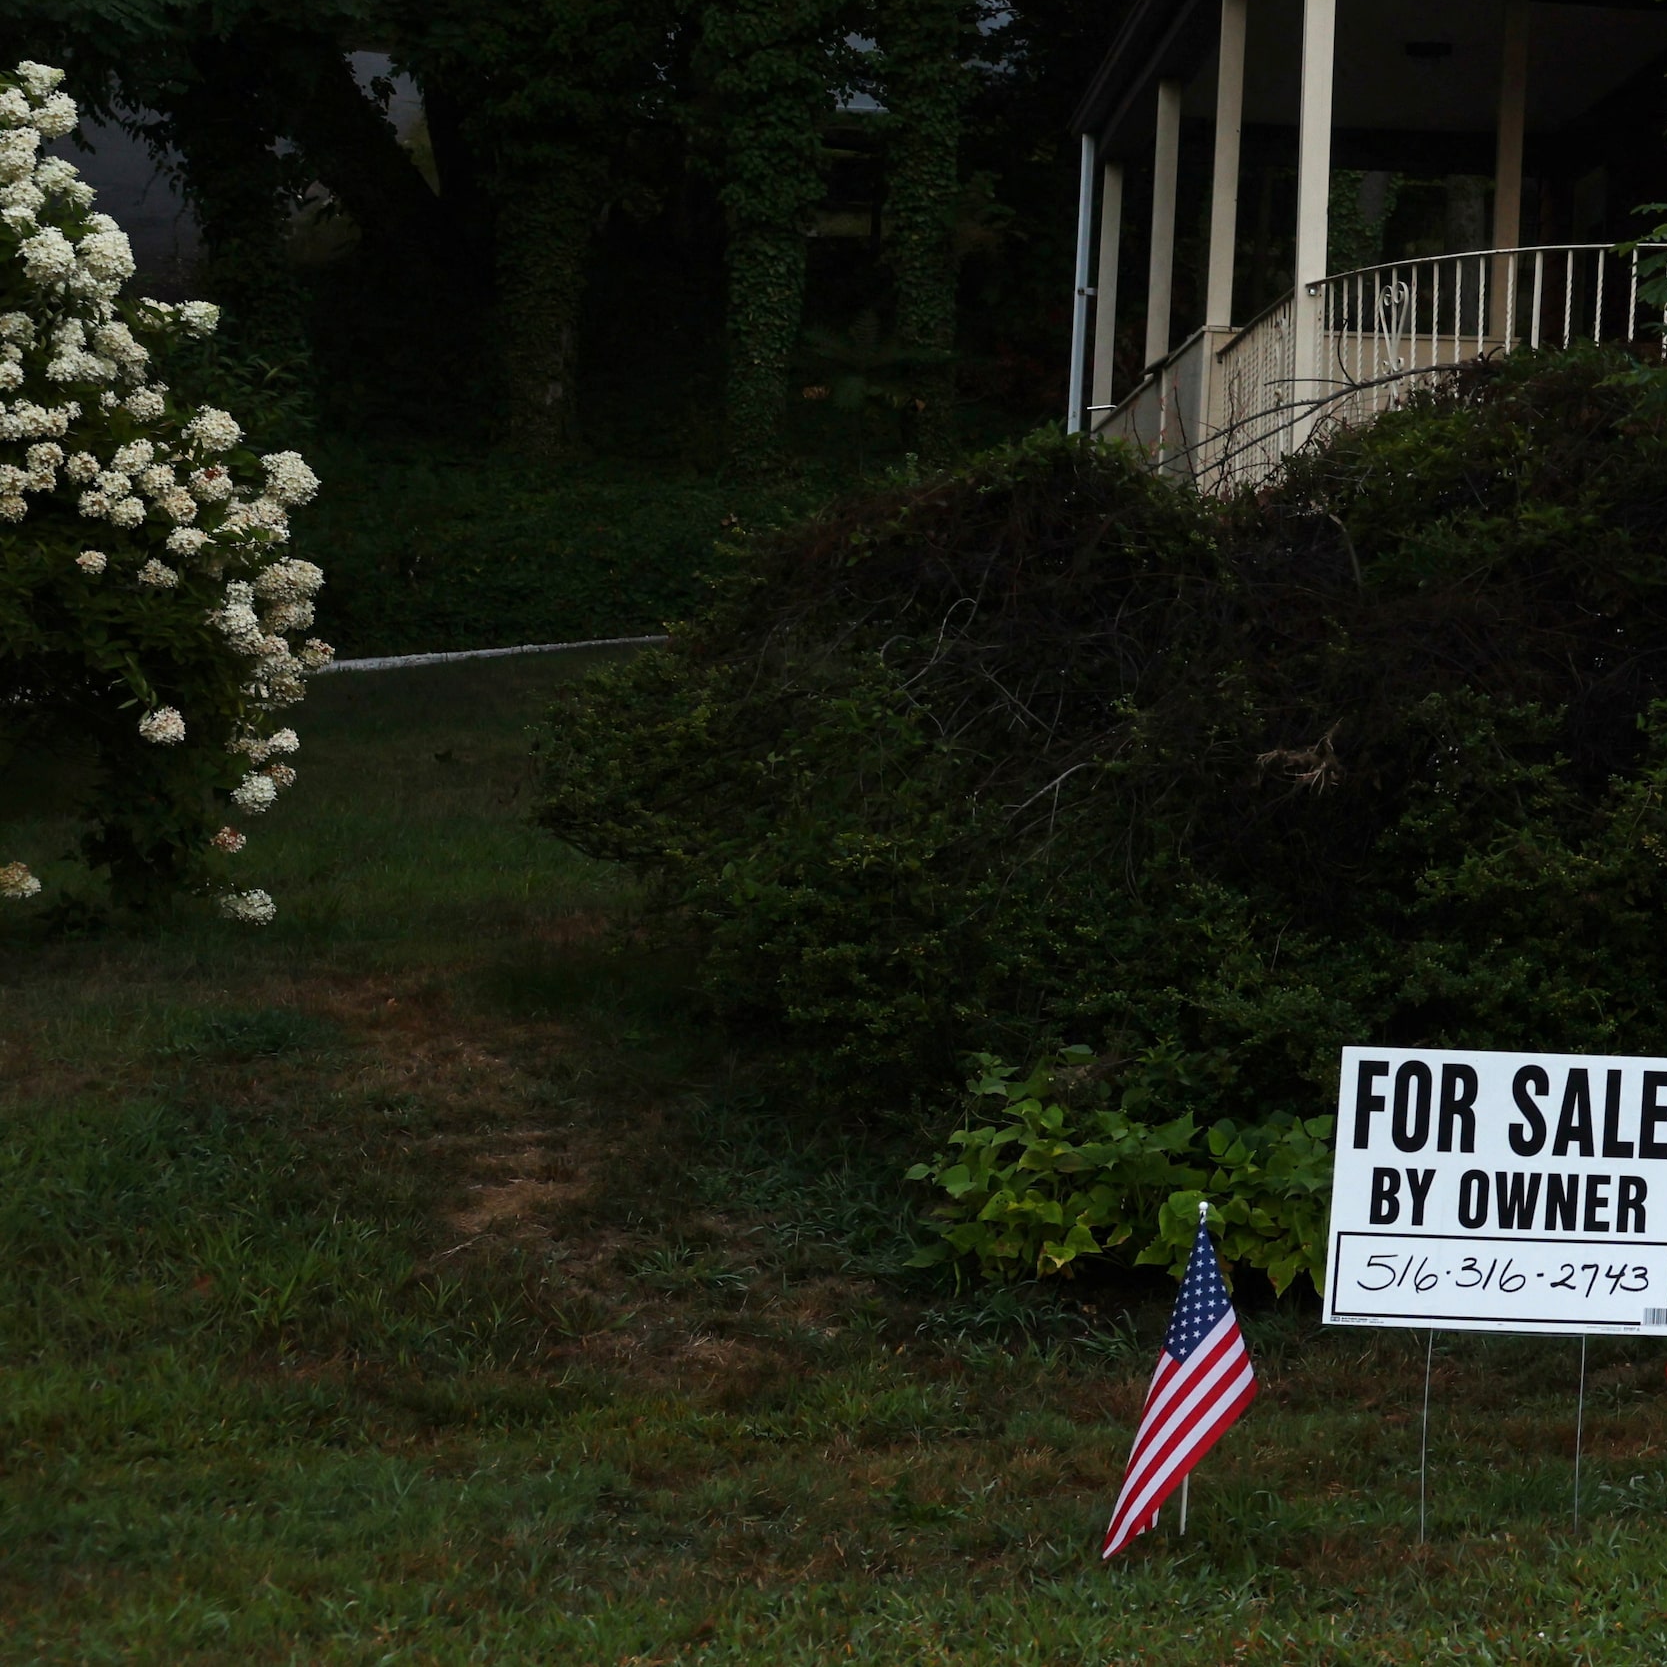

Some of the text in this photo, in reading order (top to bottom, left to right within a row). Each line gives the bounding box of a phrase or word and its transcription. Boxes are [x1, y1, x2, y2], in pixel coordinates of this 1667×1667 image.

[1353, 1059, 1479, 1154] FOR
[1369, 1166, 1648, 1234] BY OWNER
